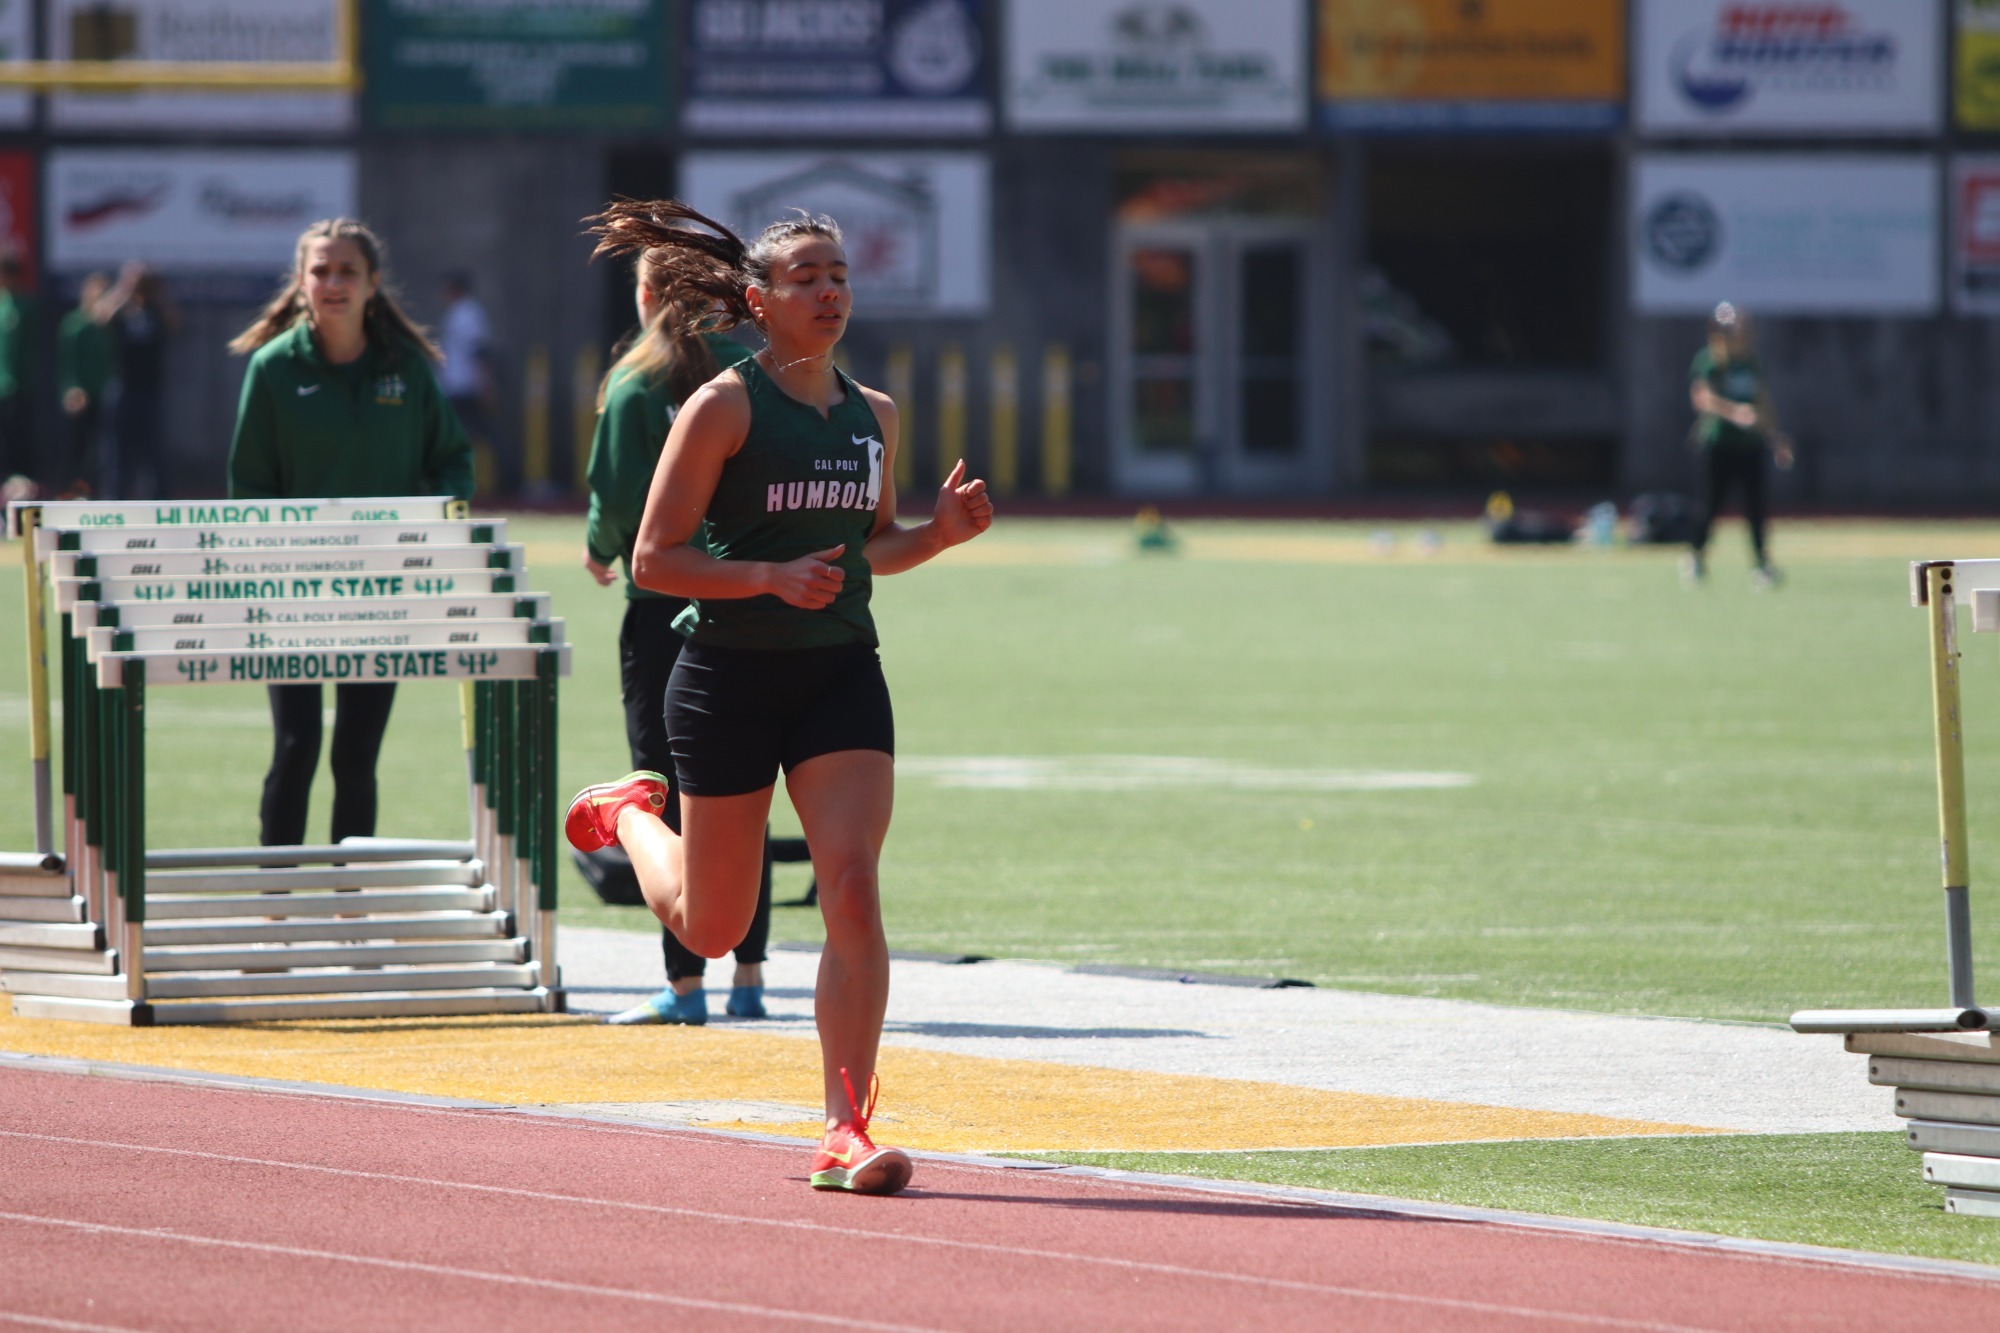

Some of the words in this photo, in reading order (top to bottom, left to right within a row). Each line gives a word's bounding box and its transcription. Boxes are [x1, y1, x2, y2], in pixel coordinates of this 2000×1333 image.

[814, 459, 833, 470] CAL
[836, 460, 859, 471] POLY
[767, 480, 879, 512] HUMBOL
[156, 506, 318, 524] HUMBOLDT
[228, 537, 252, 548] CAL
[255, 536, 286, 547] POLY
[290, 534, 360, 547] HUMBOLDT
[234, 563, 257, 573] CAL
[260, 561, 291, 573] POLY
[295, 559, 365, 572] HUMBOLDT
[187, 579, 323, 600] HUMBOLDT
[331, 576, 403, 597] STATE
[276, 613, 299, 623] CAL
[303, 612, 335, 622] POLY
[338, 609, 409, 621] HUMBOLDT
[278, 638, 302, 648] CAL
[305, 637, 335, 648] POLY
[340, 634, 411, 647] HUMBOLDT
[230, 653, 366, 680] HUMBOLDT
[374, 651, 447, 678] STATE
